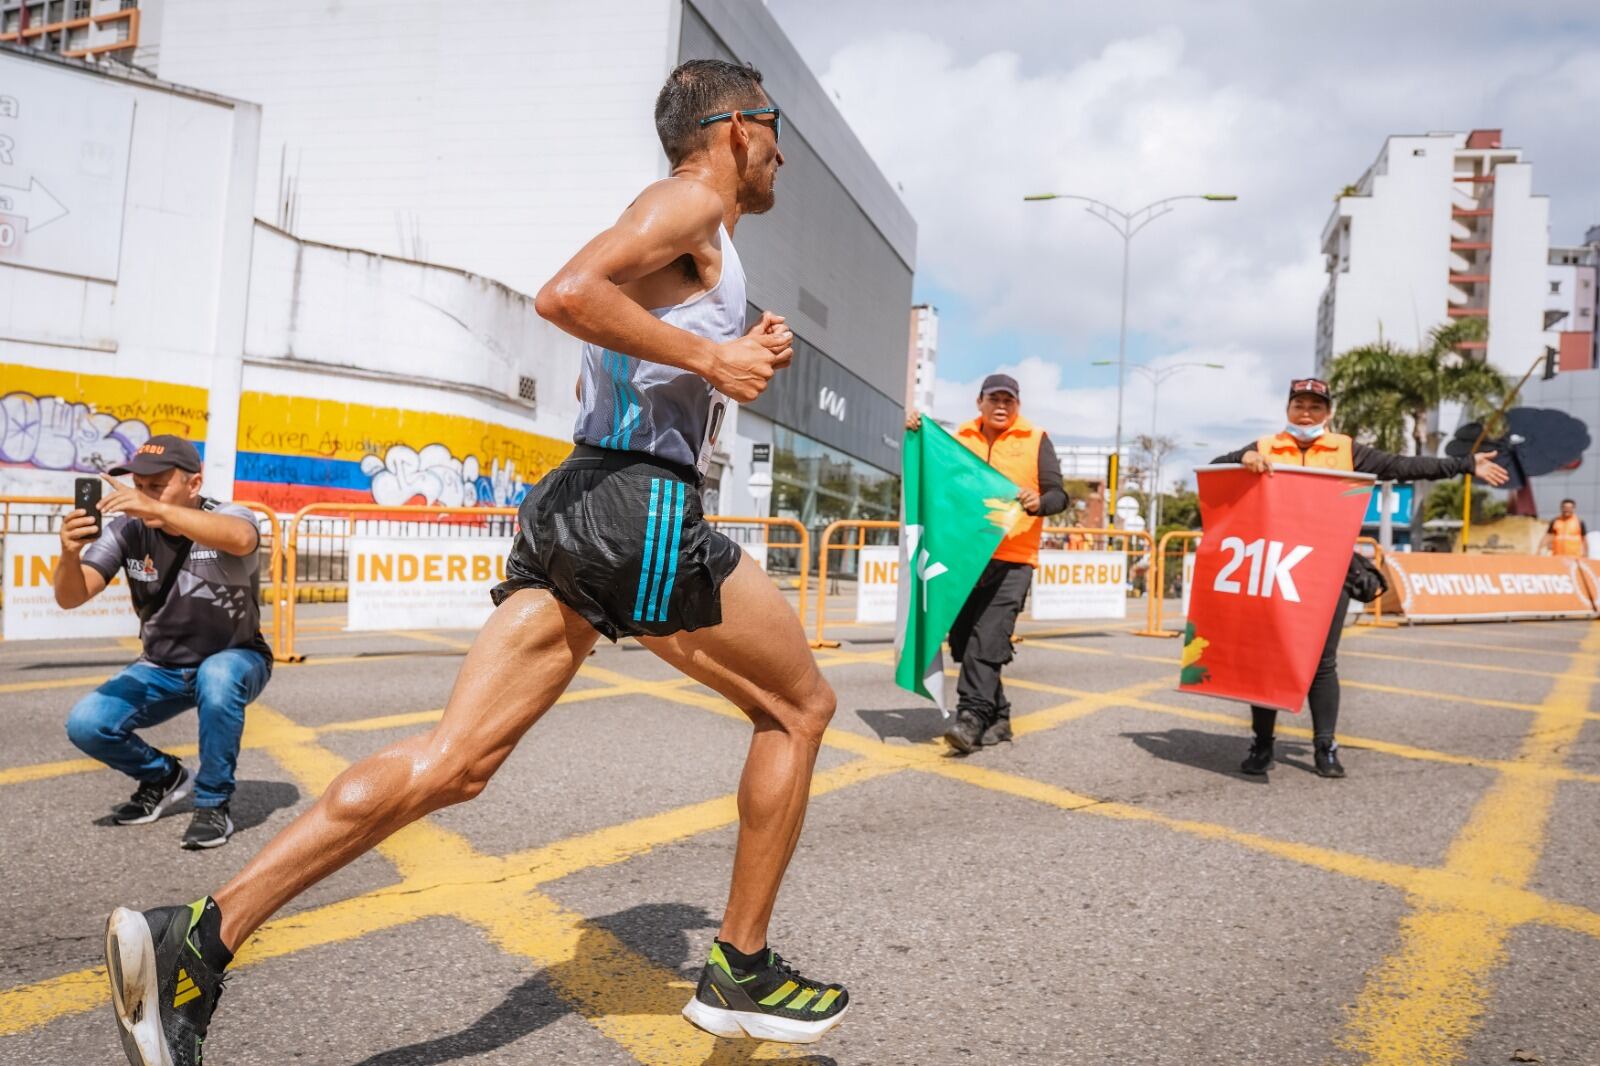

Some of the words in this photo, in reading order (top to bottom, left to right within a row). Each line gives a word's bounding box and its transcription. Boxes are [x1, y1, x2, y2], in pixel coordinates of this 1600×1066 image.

[246, 425, 310, 449] Karen
[1036, 564, 1121, 584] INDERBU
[1213, 536, 1314, 604] 21K
[1408, 573, 1500, 596] PUNTUAL
[1500, 573, 1574, 595] EVENTOS
